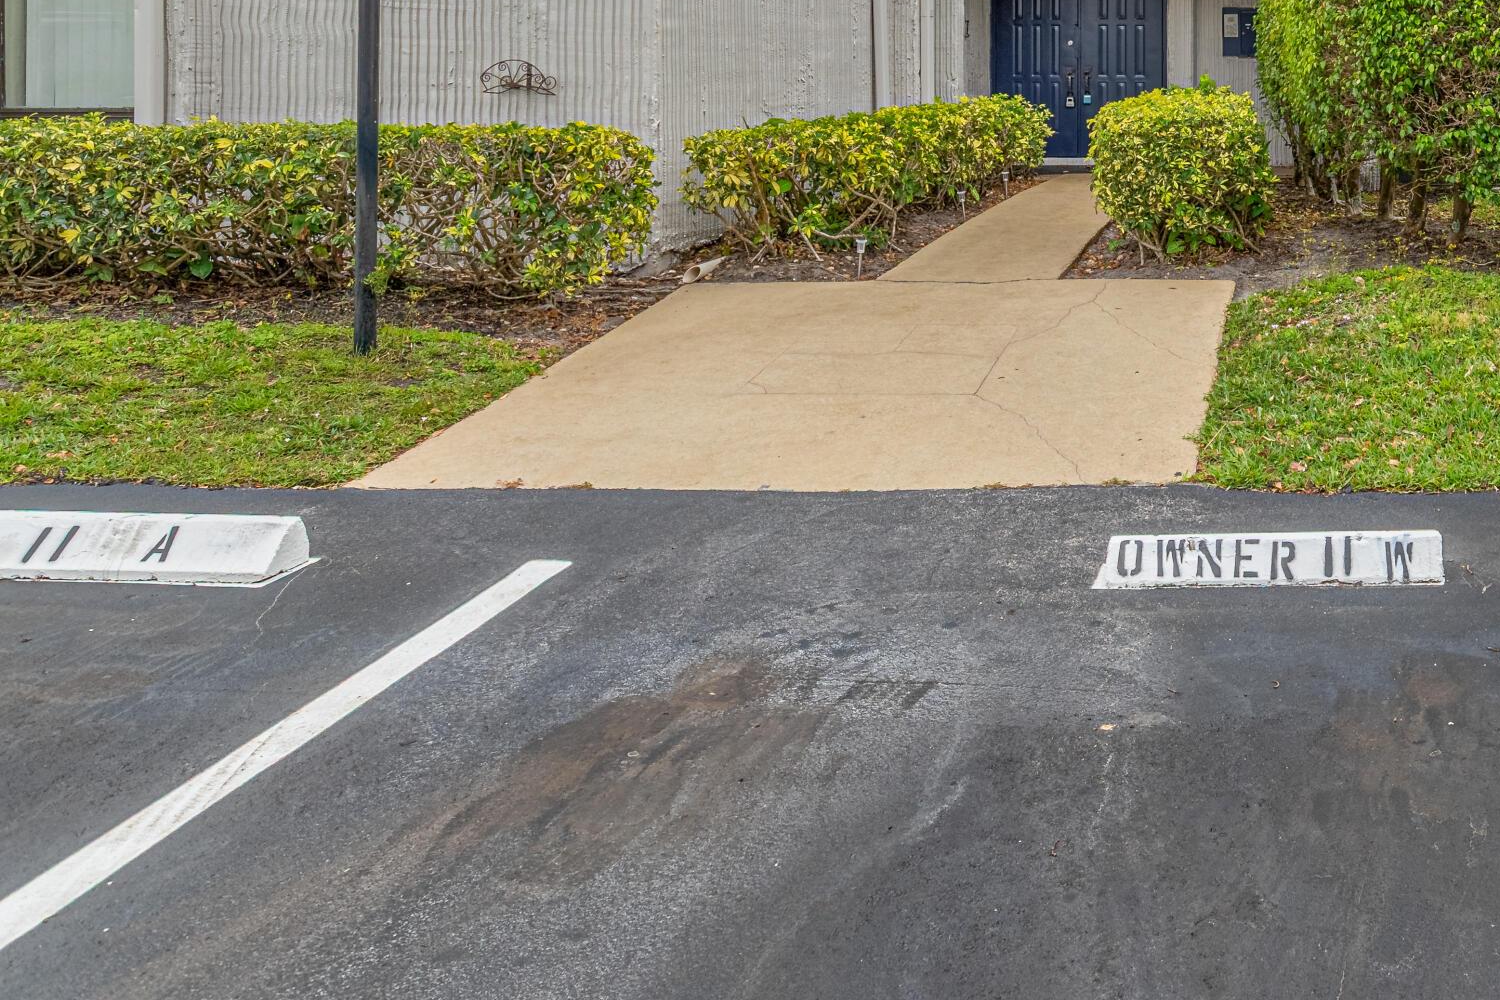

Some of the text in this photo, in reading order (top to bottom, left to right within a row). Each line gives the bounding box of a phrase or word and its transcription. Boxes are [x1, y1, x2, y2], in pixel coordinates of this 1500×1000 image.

[140, 525, 180, 563] A
[1117, 538, 1296, 580] OWNER
[1385, 540, 1414, 581] W
